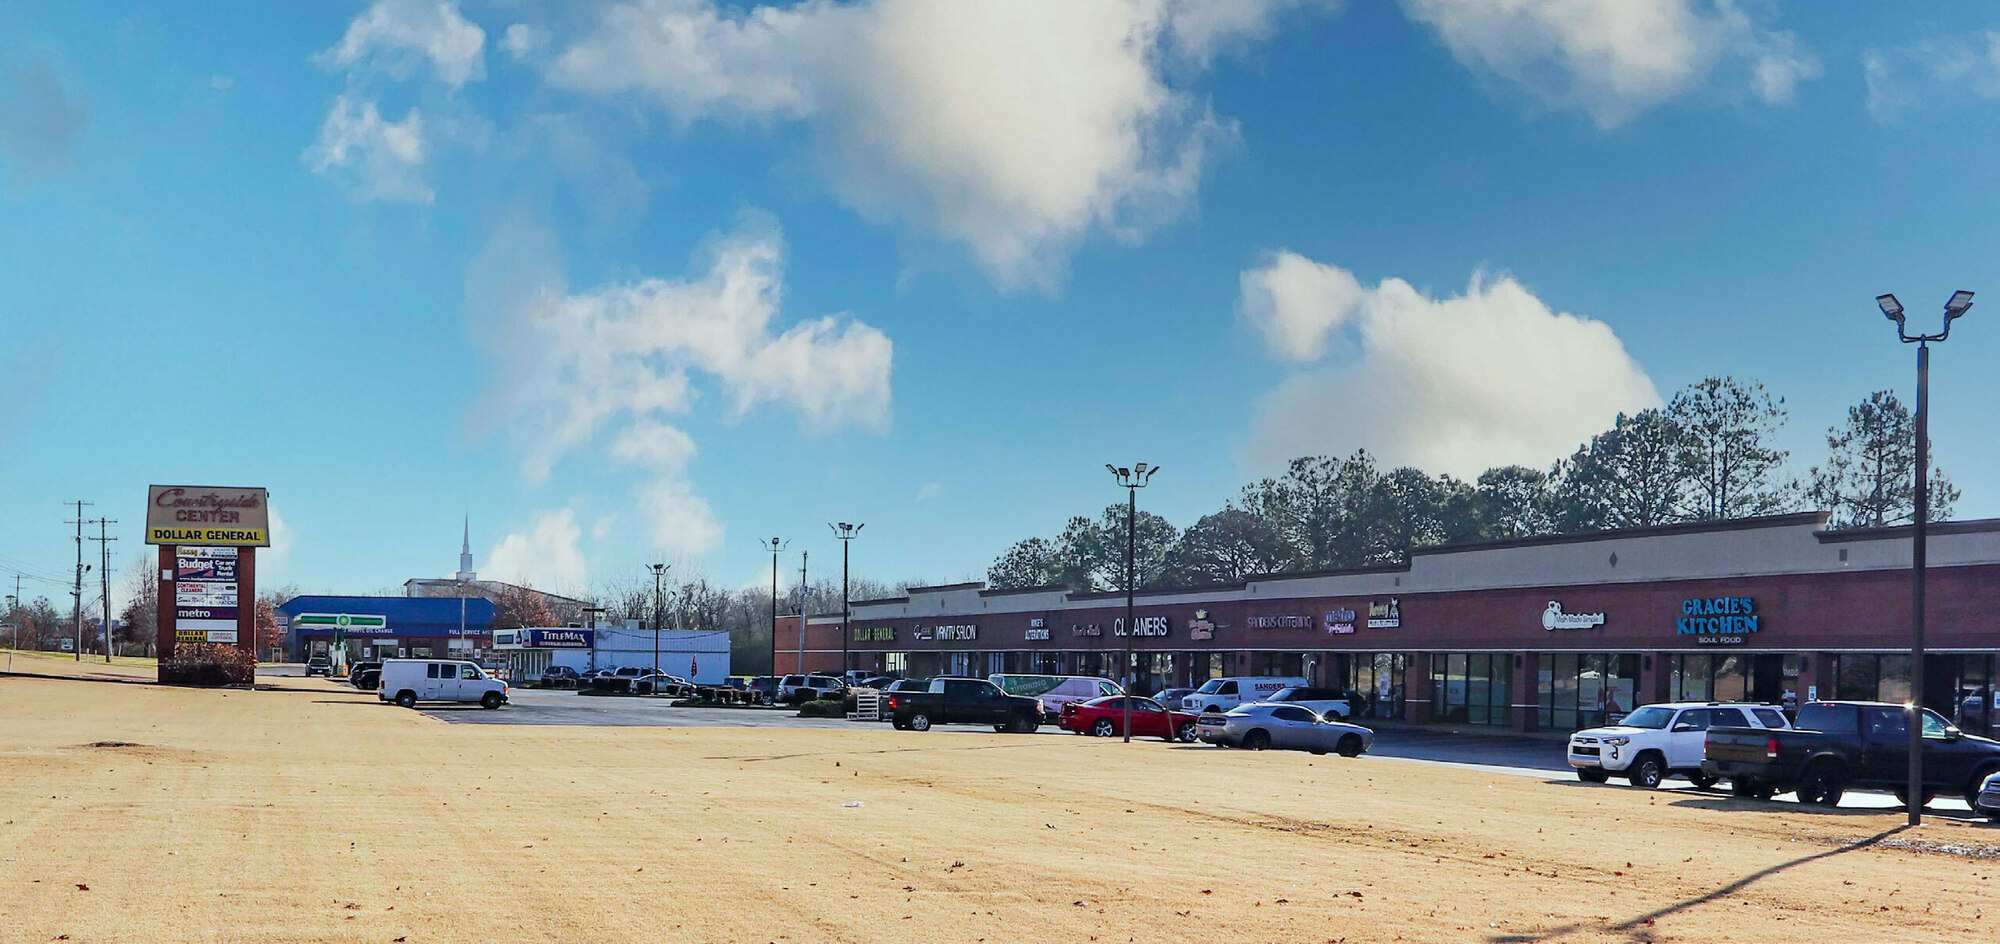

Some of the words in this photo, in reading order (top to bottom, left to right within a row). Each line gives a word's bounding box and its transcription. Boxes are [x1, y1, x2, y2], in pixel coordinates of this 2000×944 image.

[156, 488, 260, 512] Countryside
[176, 509, 240, 523] CENTER
[154, 529, 202, 540] DOLLAR
[206, 530, 261, 541] GENERAL
[178, 559, 214, 571] Budget
[1682, 597, 1753, 614] GRACIE'S
[178, 609, 211, 618] metro
[935, 625, 955, 640] VANITY
[956, 625, 976, 640] SALON
[1114, 617, 1168, 636] CLANERS
[1676, 615, 1758, 635] KITCHEN
